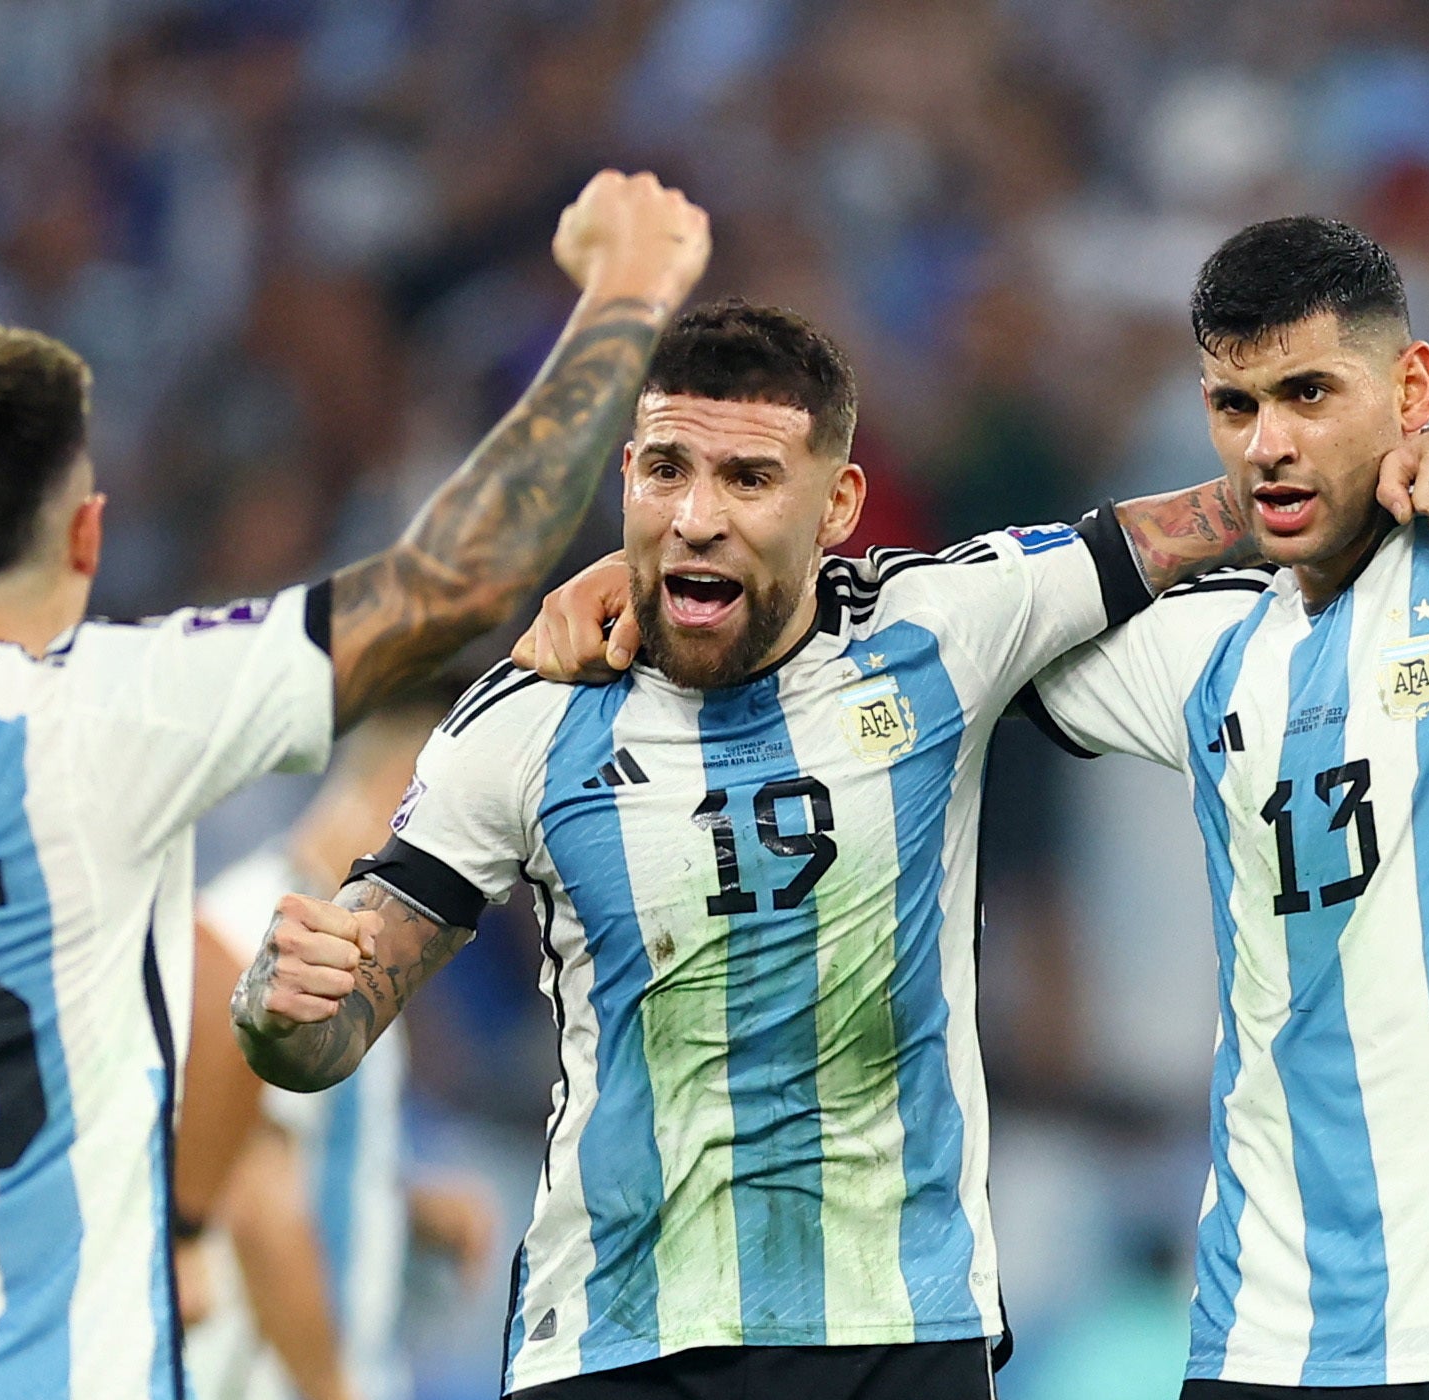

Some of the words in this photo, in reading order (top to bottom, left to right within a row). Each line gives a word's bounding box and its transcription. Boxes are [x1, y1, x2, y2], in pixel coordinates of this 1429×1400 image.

[860, 700, 898, 738] AFA
[690, 775, 838, 917] 19
[1259, 757, 1381, 917] 13
